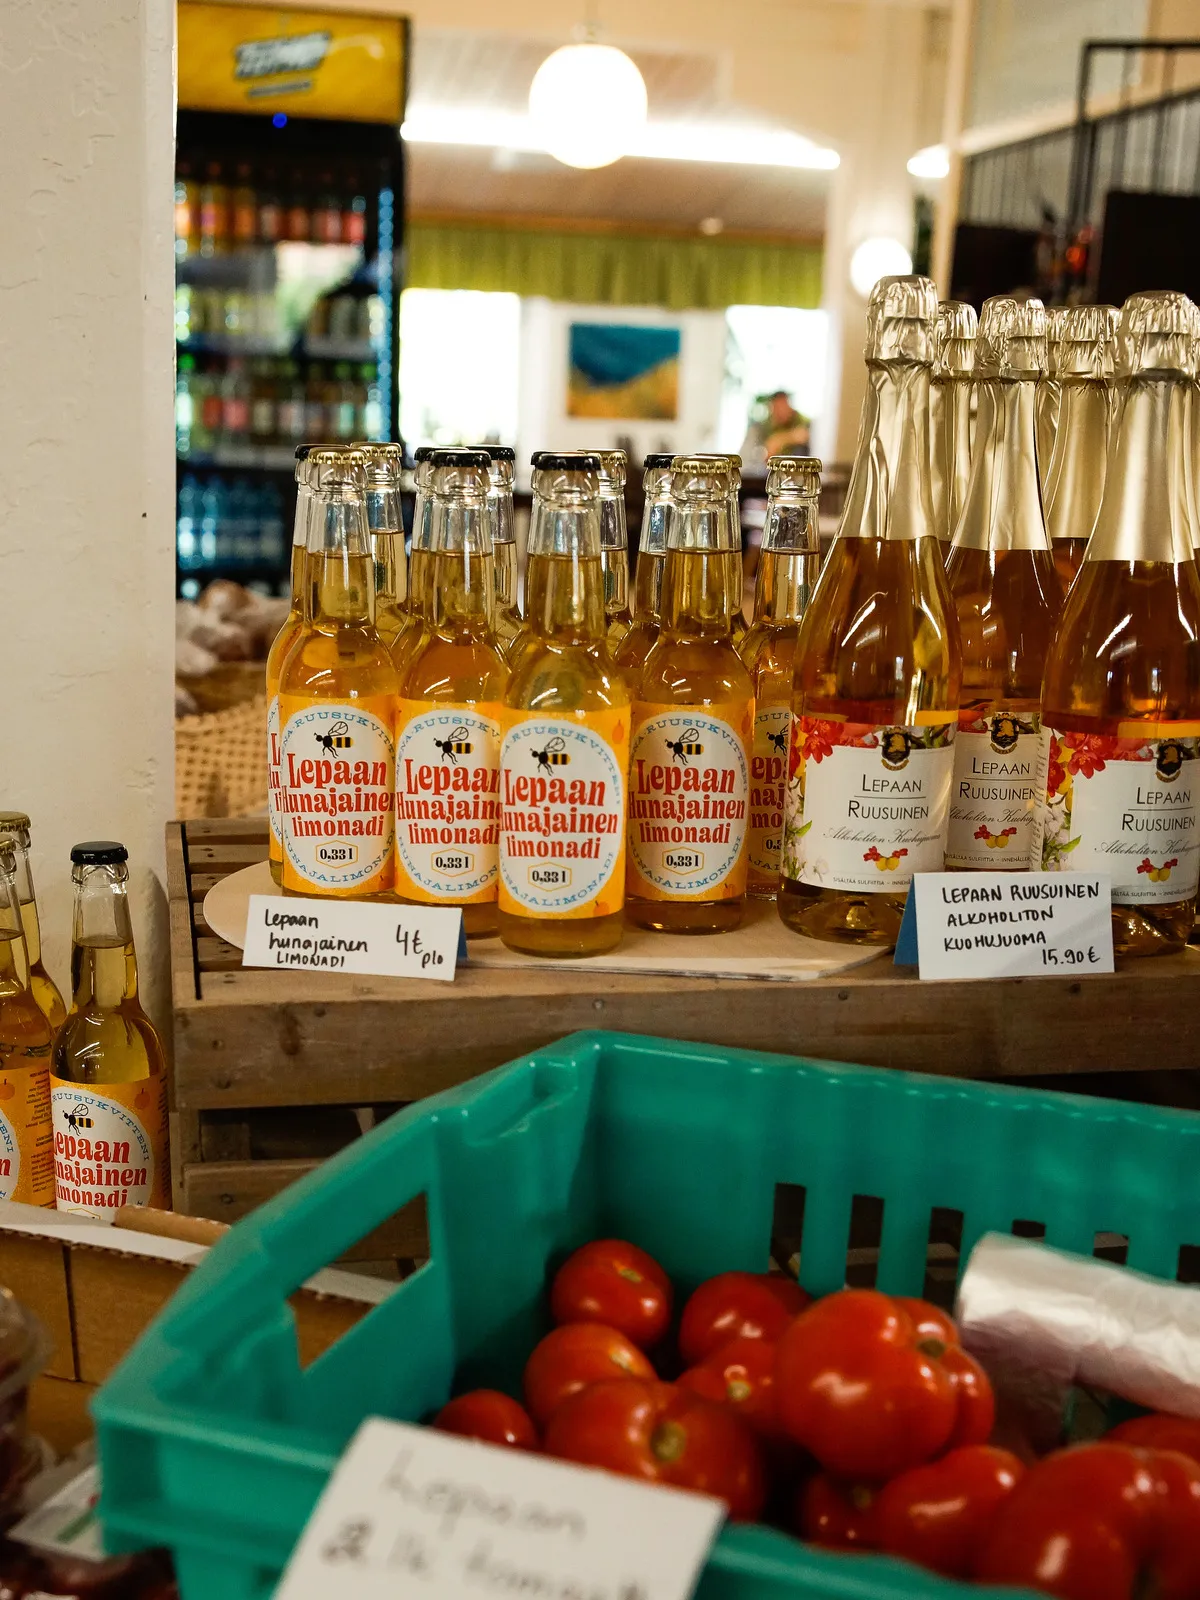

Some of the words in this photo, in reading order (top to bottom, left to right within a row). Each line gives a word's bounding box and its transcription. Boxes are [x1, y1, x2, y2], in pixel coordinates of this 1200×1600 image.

[287, 753, 387, 789] Lepaan
[972, 757, 1031, 775] LEPAAN
[503, 768, 606, 808] Lepaan
[636, 759, 736, 796] Lepaan
[862, 774, 922, 793] LEPAAN
[1137, 786, 1191, 805] LEPAAN
[628, 790, 746, 824] Hunajainen
[848, 799, 929, 820] RUUSUINEN
[292, 815, 384, 837] limonadi
[639, 822, 731, 844] limonadi
[1121, 813, 1196, 832] RUUSUINEN
[408, 823, 500, 845] limonadi
[319, 848, 346, 862] 0,33
[506, 836, 601, 859] limonadi
[435, 856, 462, 870] 0,33
[666, 855, 692, 869] 0,33
[532, 870, 559, 884] 0,33
[942, 885, 1002, 904] LEPAAN
[1010, 882, 1100, 901] RUUSUINEN
[947, 905, 1054, 927] ALKOHOLITON
[269, 932, 368, 956] hunajainen
[277, 951, 345, 968] LIMONADI
[54, 1131, 130, 1164] epaan
[56, 1160, 147, 1187] najainen
[57, 1179, 128, 1208] imonadi
